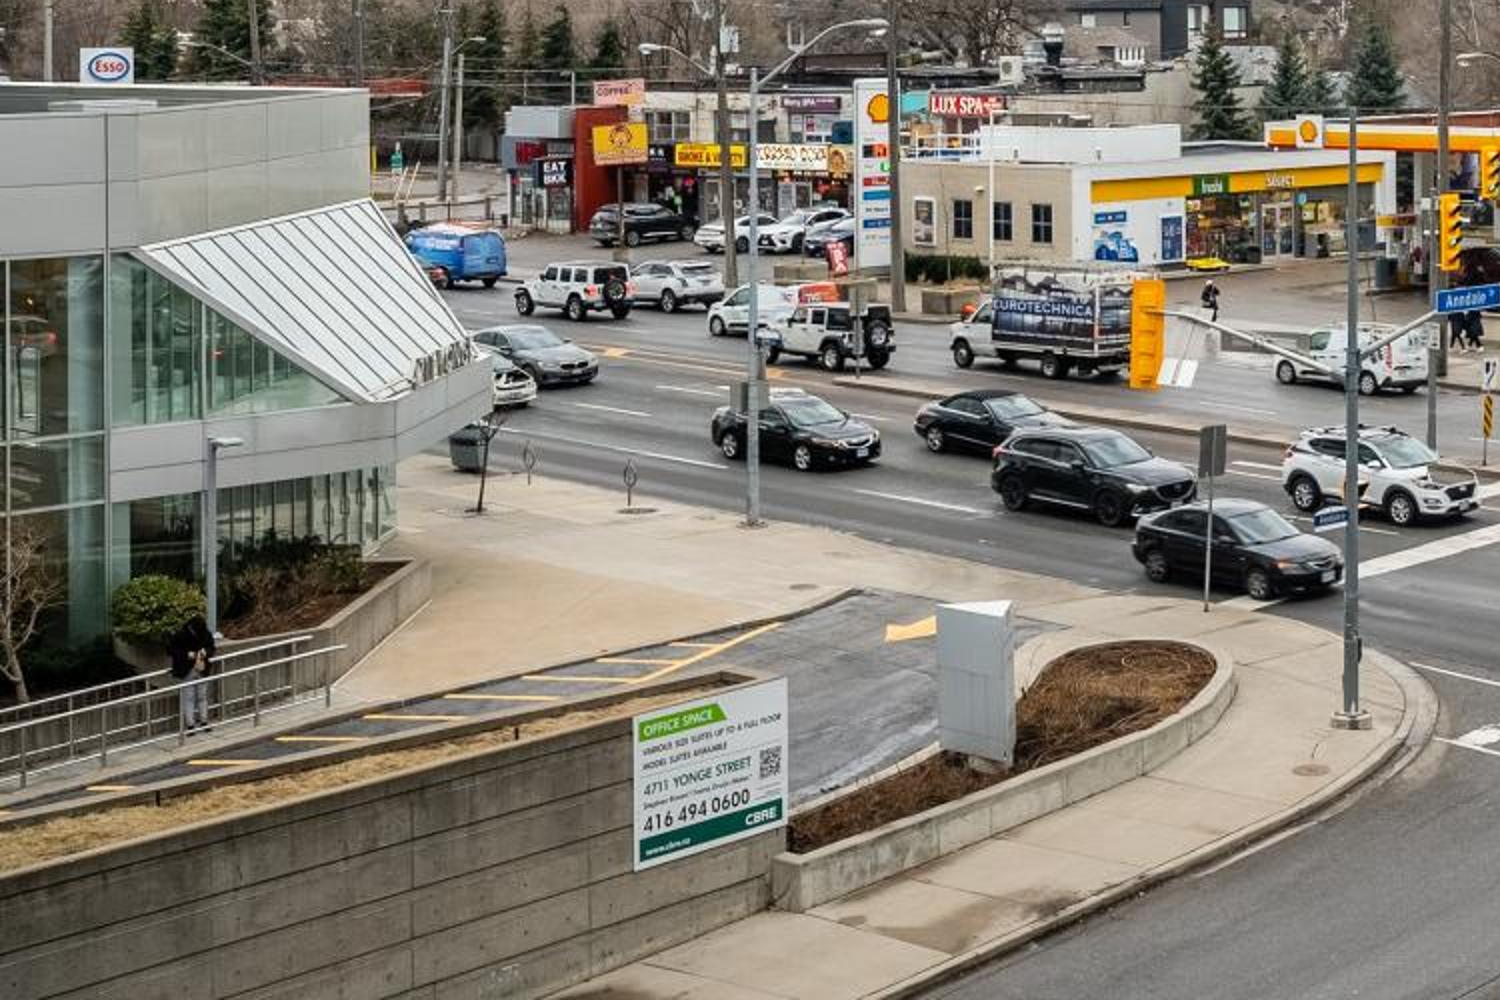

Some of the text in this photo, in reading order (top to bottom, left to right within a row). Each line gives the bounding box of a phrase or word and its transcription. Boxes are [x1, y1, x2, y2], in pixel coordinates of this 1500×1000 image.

[932, 96, 957, 113] LUX
[960, 96, 984, 115] SPA
[544, 161, 567, 172] EAT
[1446, 291, 1487, 309] Anndale
[643, 709, 713, 737] OFFICE SPACE
[714, 727, 725, 737] UP
[643, 779, 669, 796] 4711
[672, 767, 712, 788] YONGE
[715, 756, 752, 777] STREET
[643, 810, 674, 832] 416
[678, 799, 708, 823] 494
[711, 788, 750, 813] 0600
[745, 806, 778, 826] CBRE
